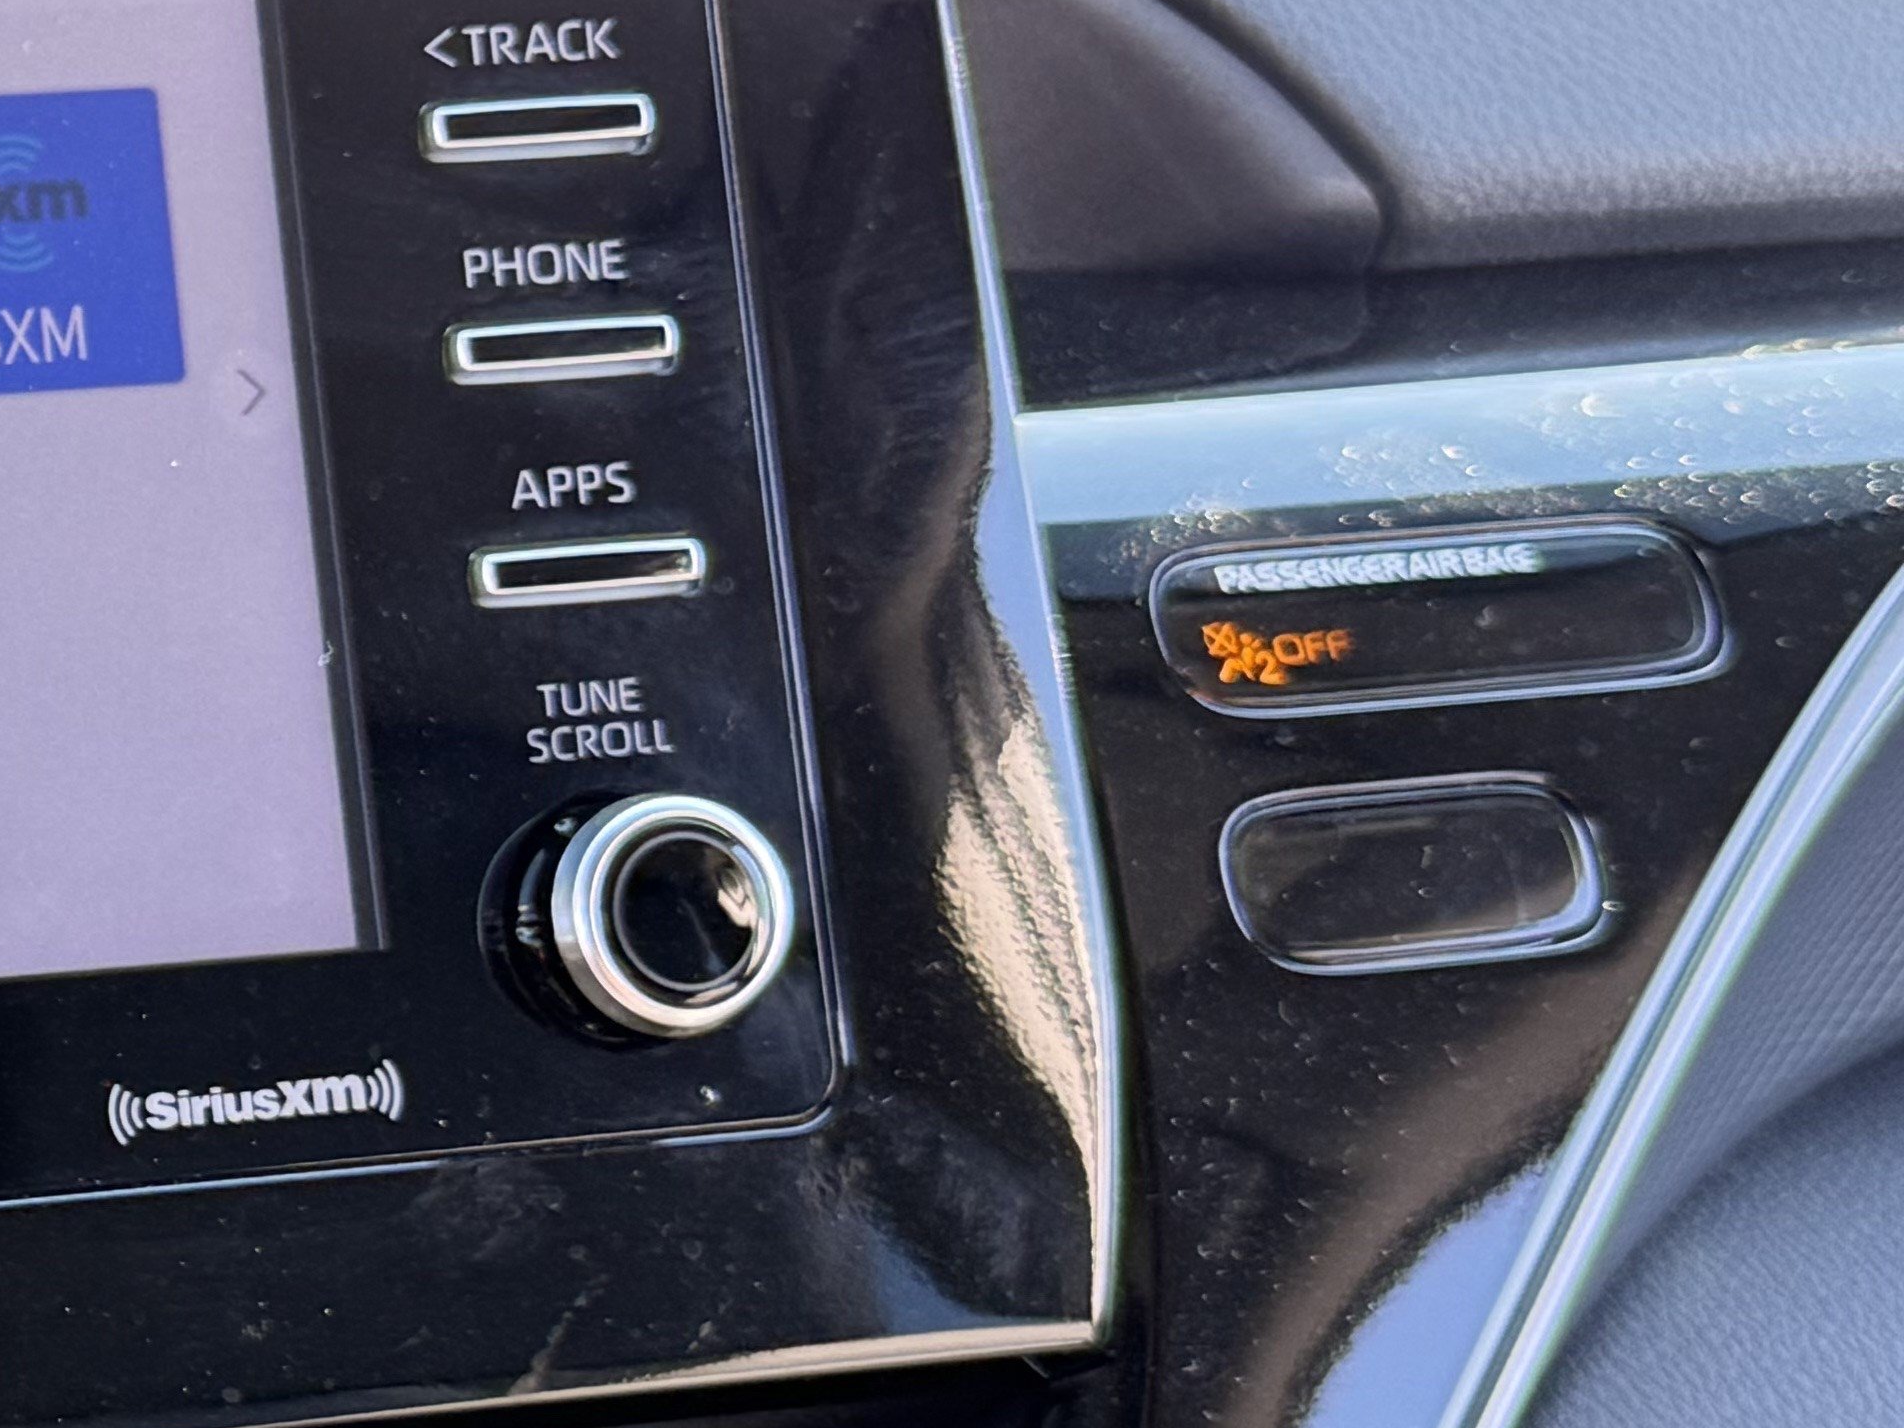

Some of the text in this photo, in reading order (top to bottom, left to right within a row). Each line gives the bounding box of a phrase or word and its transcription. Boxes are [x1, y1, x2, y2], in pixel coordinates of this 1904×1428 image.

[464, 240, 627, 288] PHONE
[512, 462, 635, 509] APPS
[1214, 542, 1539, 593] PASSENGER AIRBAG
[1273, 628, 1354, 666] OFF
[537, 677, 641, 717] TUNE
[527, 720, 673, 762] SCROLL
